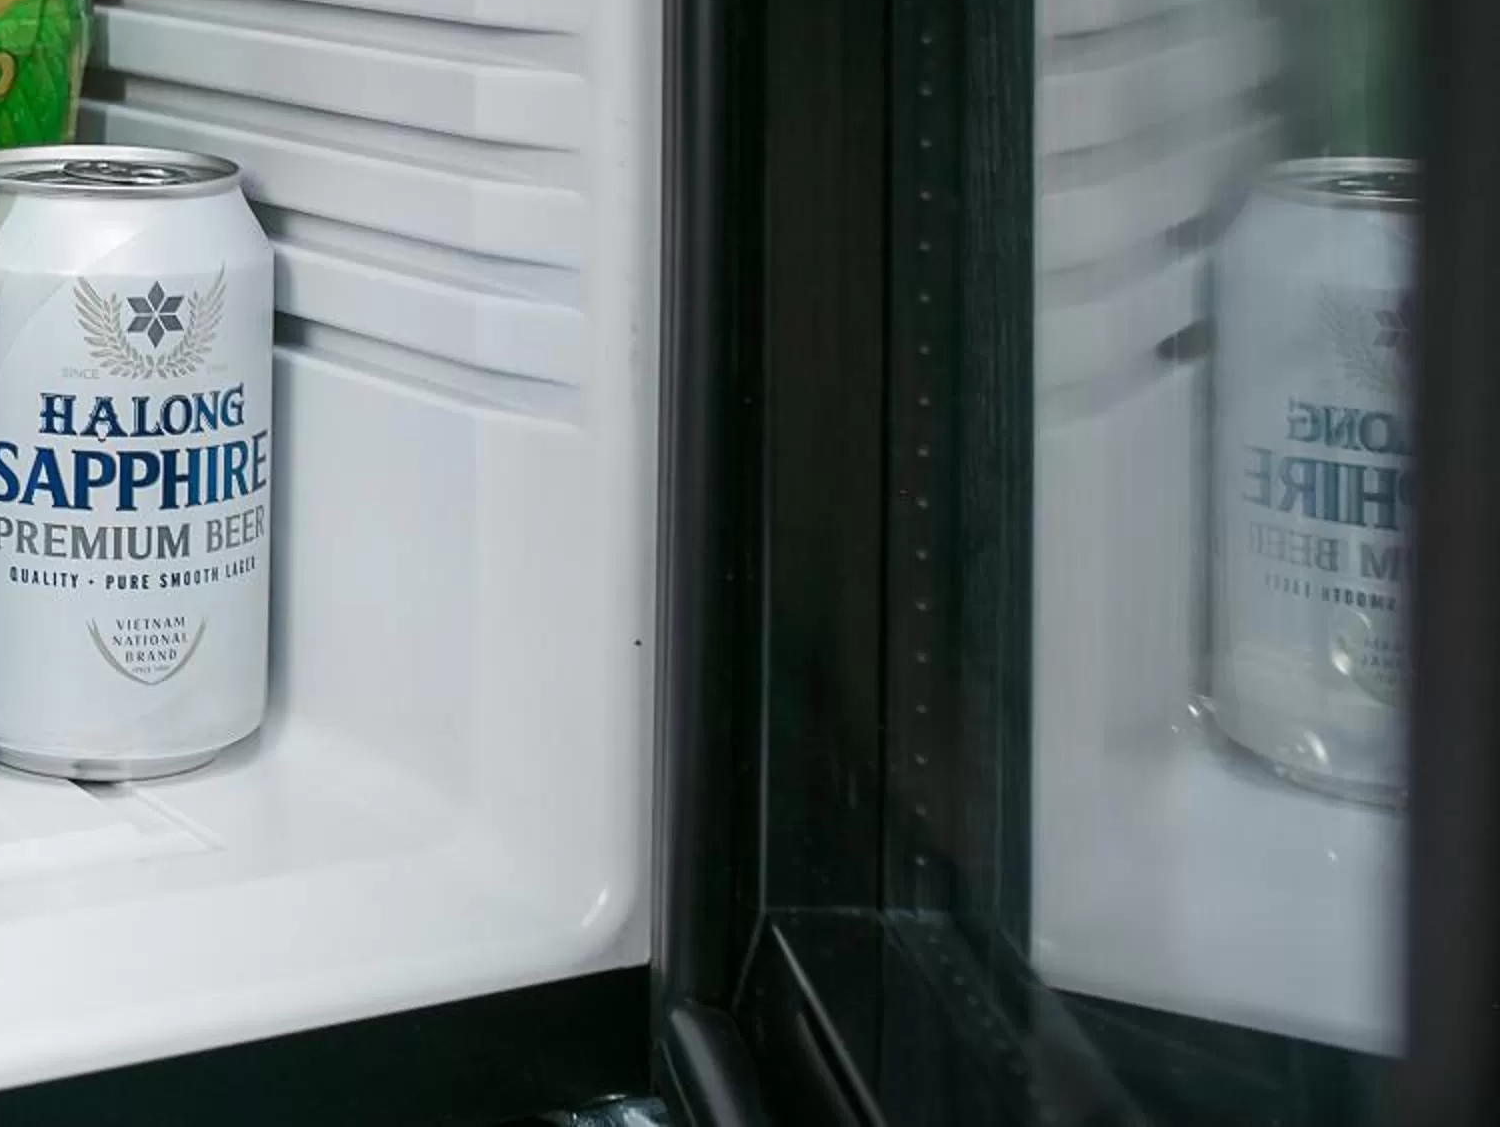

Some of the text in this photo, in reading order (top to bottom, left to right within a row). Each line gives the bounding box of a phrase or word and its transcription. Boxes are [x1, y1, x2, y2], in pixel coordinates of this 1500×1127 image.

[206, 504, 266, 555] BEER
[9, 565, 80, 590] QUALITY
[105, 570, 149, 591] PURE
[159, 565, 220, 590] SMOOTH
[116, 616, 186, 632] VIETNAM
[112, 632, 188, 647] NATIONAL
[125, 649, 178, 663] BRAND
